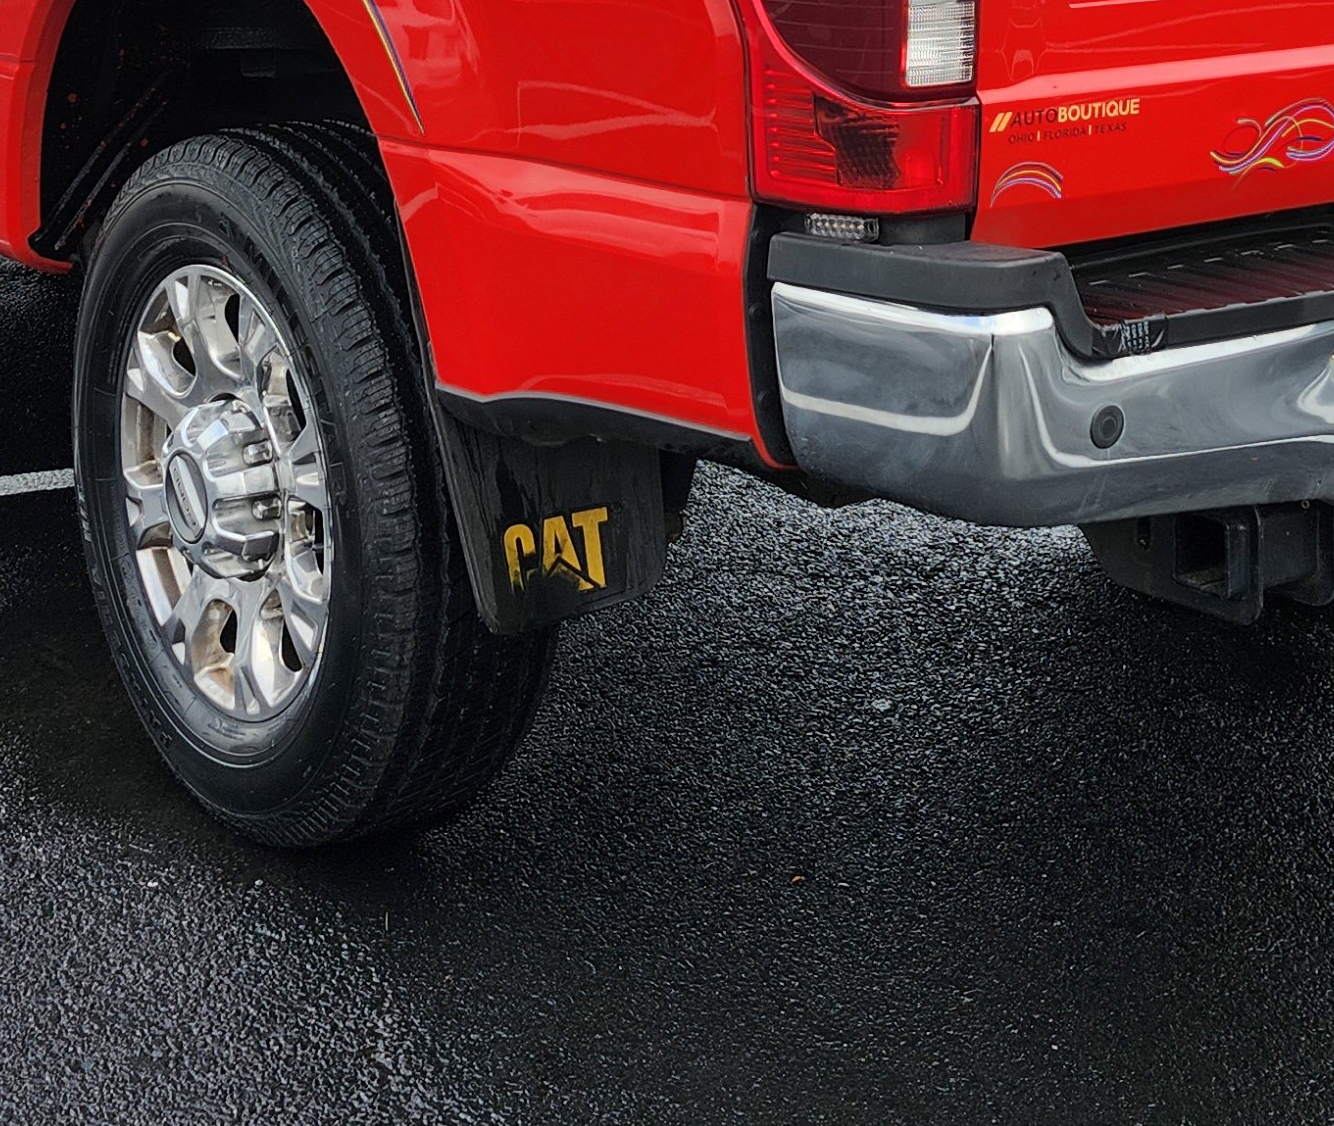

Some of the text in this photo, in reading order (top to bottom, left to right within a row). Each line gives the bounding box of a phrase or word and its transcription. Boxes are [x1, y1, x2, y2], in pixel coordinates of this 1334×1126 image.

[1010, 98, 1141, 127] AUTOBOUTIQUE
[1008, 122, 1127, 145] OHIO FLORIDA TEXAS
[503, 506, 608, 594] CAT
